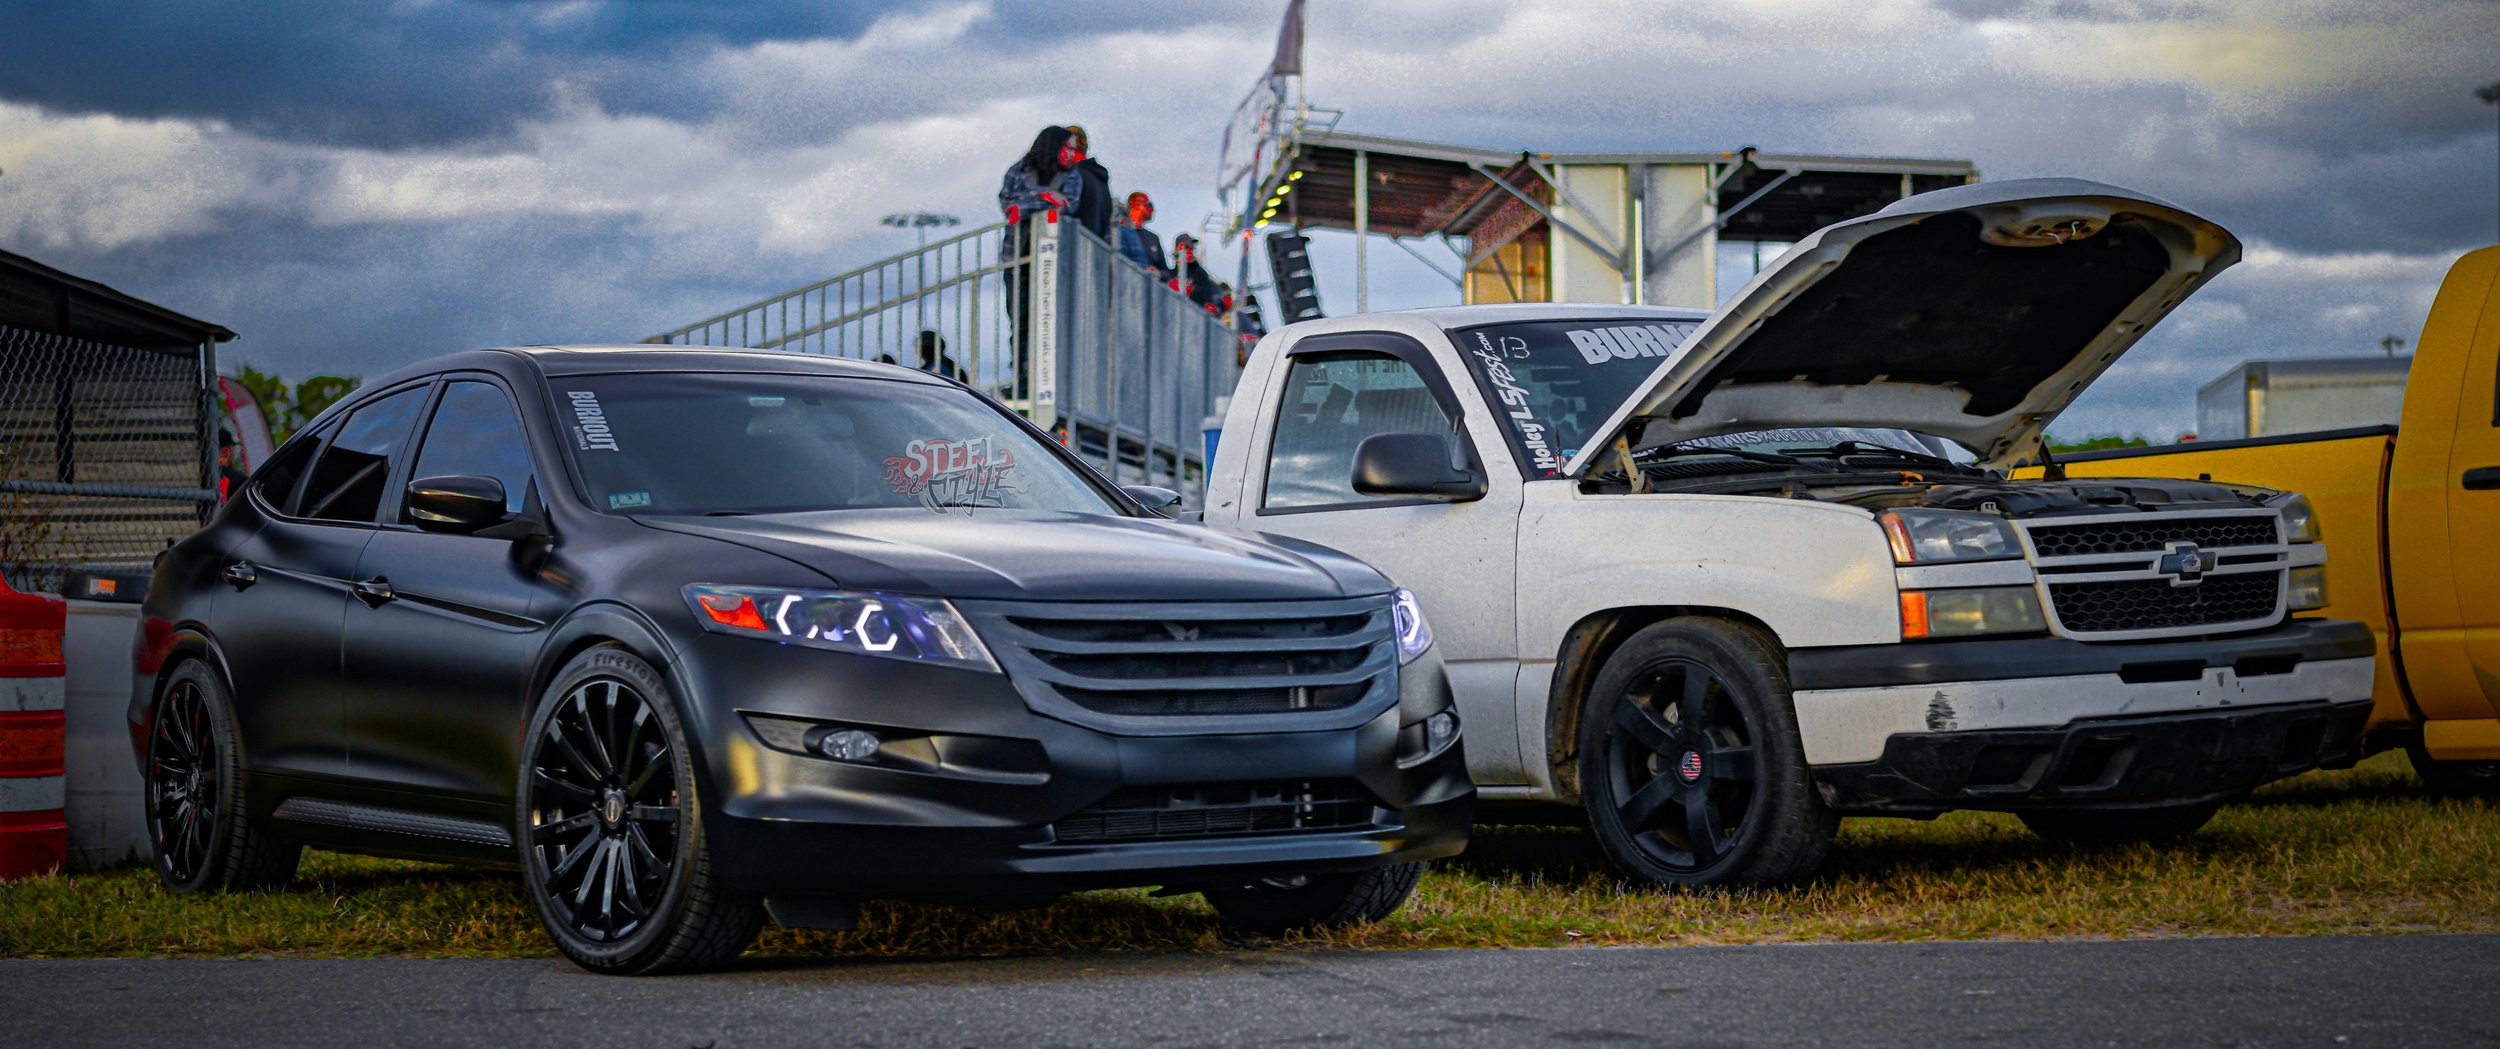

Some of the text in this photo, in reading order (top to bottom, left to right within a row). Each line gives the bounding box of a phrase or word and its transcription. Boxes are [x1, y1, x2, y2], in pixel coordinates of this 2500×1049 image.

[567, 391, 620, 452] BURNOUT
[904, 434, 1004, 480] STEEL
[1521, 423, 1557, 469] Holley
[908, 463, 1017, 518] & STYLE
[594, 653, 664, 696] Firestone
